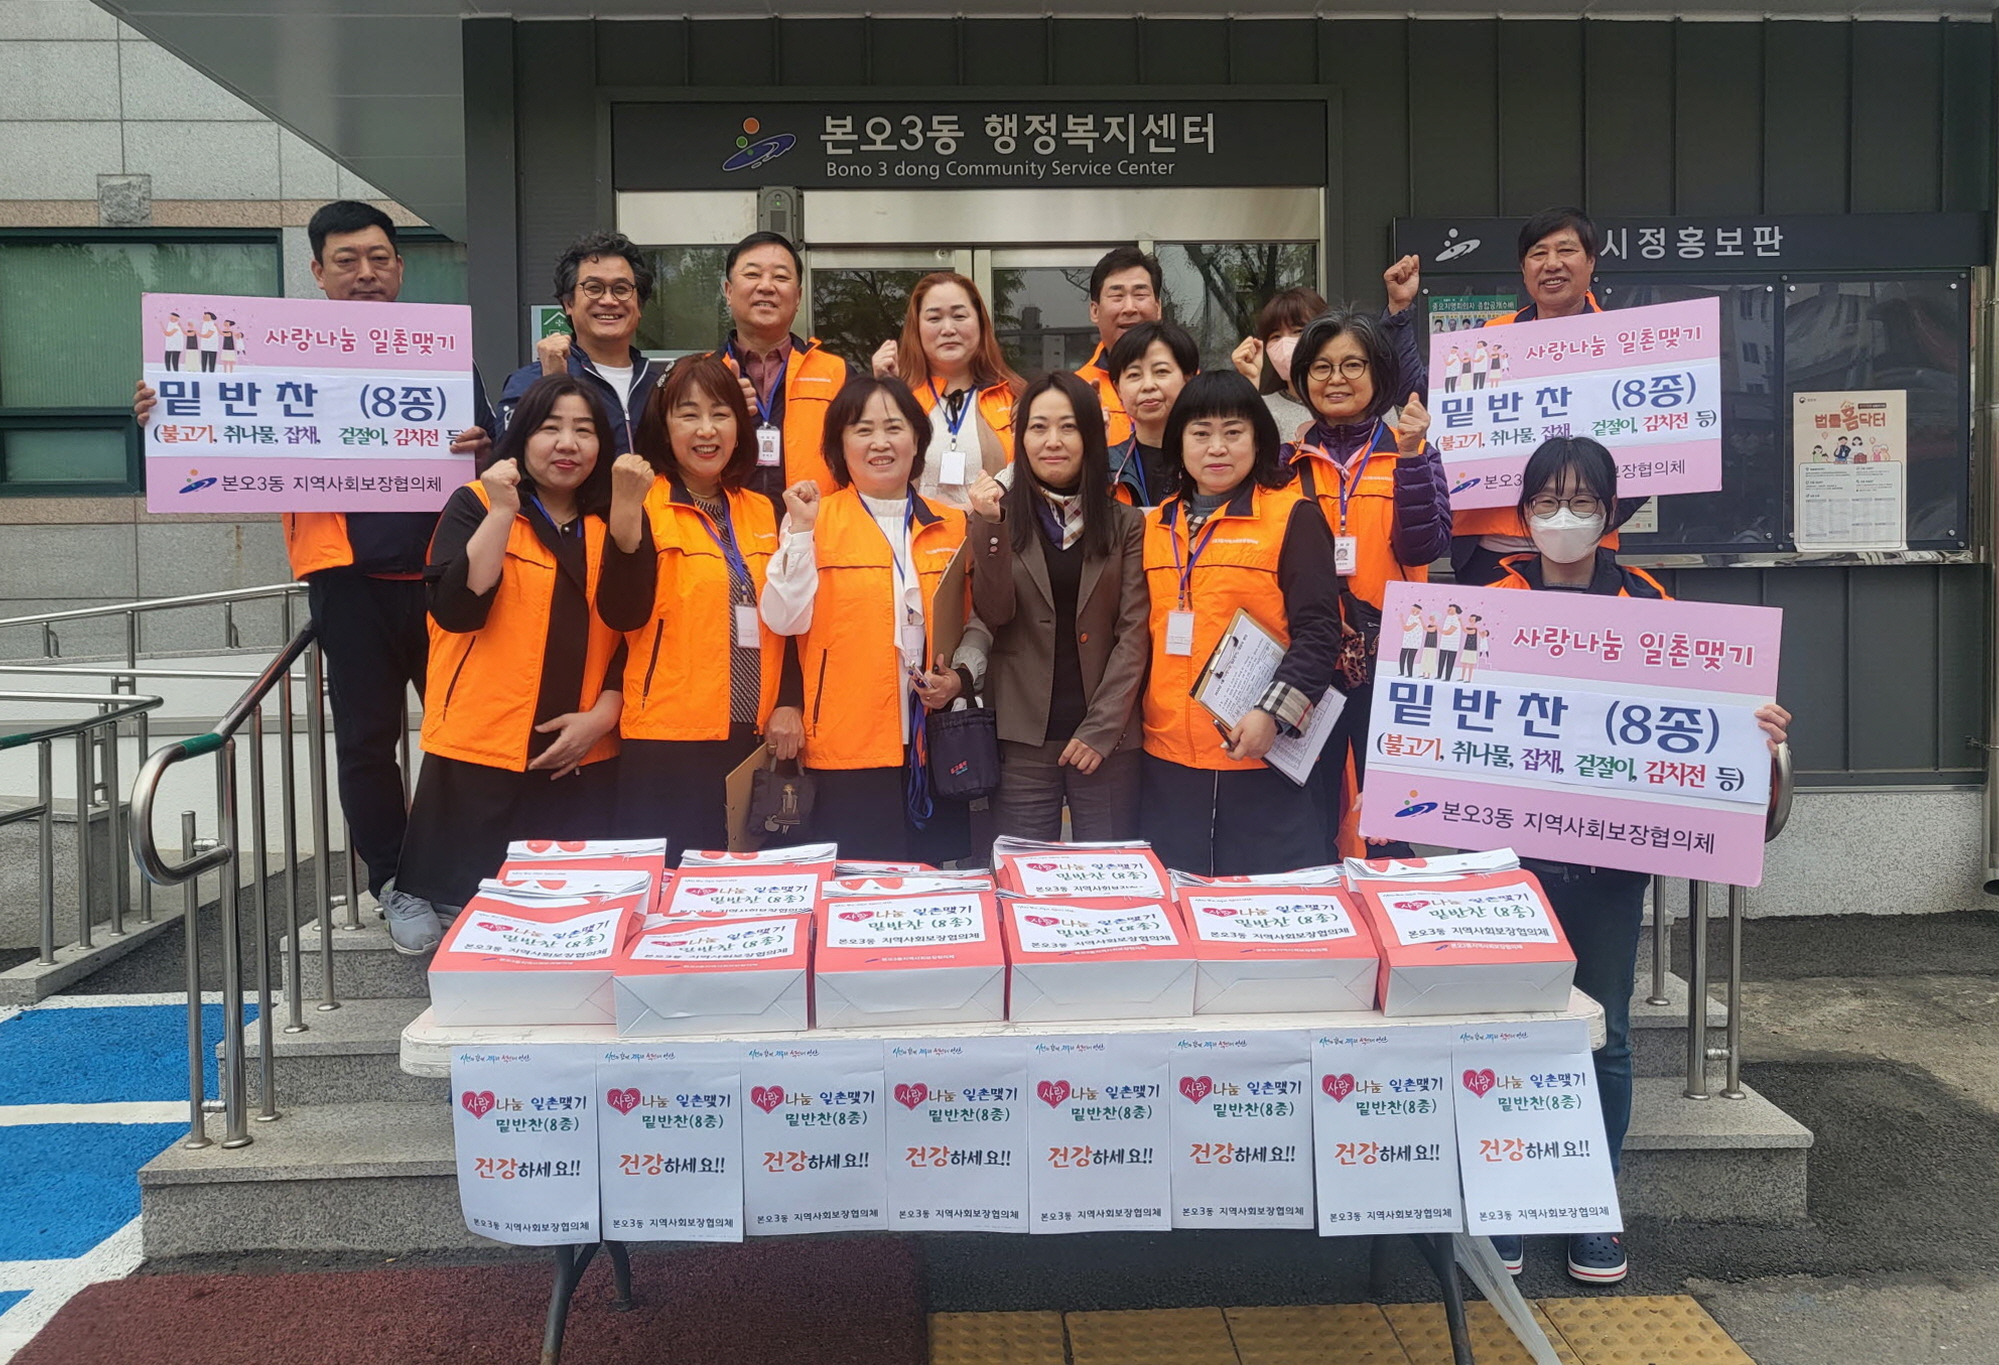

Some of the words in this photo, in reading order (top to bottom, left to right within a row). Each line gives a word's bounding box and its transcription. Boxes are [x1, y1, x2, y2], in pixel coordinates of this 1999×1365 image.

[820, 115, 964, 155] 본오3동
[984, 113, 1215, 156] 행정복지센터
[826, 161, 873, 177] Bono
[878, 162, 888, 177] 3
[894, 161, 940, 180] dong
[945, 160, 1047, 180] Community
[1051, 160, 1112, 177] Service
[1117, 160, 1175, 177] Center
[1600, 225, 1784, 260] 시정홍보판
[265, 328, 356, 352] 사랑나눔
[369, 329, 455, 353] 일촌맺기
[1525, 336, 1607, 362] 사랑나눔
[1617, 326, 1701, 353] 일촌맺기
[1611, 371, 1697, 411] (8종)
[360, 384, 446, 421] (8종)
[153, 424, 218, 444] (불고기,
[223, 425, 278, 444] 취나물,
[283, 425, 321, 444] 잡채,
[338, 426, 388, 446] 겉절이,
[392, 428, 439, 447] 김치전
[1435, 431, 1485, 453] (불고기,
[1489, 427, 1537, 447] 취나물,
[1591, 417, 1639, 437] 겉절이,
[1642, 412, 1689, 434] 김치전
[1695, 409, 1718, 429] 등)
[221, 475, 285, 492] 본오3동
[293, 475, 442, 493] 지역사회보장협의체
[1484, 473, 1523, 489] 본오3
[1512, 627, 1624, 662] 사랑나눔
[1640, 632, 1754, 671] 일촌맺기
[1605, 700, 1720, 755] (8종)
[1376, 732, 1445, 762] (불고기,
[1451, 741, 1514, 770] 취나물,
[1520, 748, 1565, 775] 잡채,
[1574, 754, 1638, 783] 겉절이,
[1644, 760, 1706, 789] 김치전
[1715, 768, 1744, 792] 등)
[1441, 801, 1514, 830] 본오3동
[1522, 811, 1715, 855] 지역사회보장협의체
[1247, 1080, 1301, 1096] 일촌맺기
[1389, 1077, 1443, 1092] 일촌맺기
[1529, 1072, 1586, 1089] 일촌맺기
[675, 1093, 731, 1108] 일촌맺기
[819, 1090, 875, 1105] 일촌맺기
[962, 1087, 1018, 1103] 일촌맺기
[1105, 1084, 1160, 1099] 일촌맺기
[530, 1095, 587, 1111] 일촌맺기
[1213, 1101, 1294, 1118] 밑반찬(8종)
[1356, 1100, 1437, 1117] 밑반찬(8종)
[1497, 1094, 1582, 1112] 밑반찬(8종)
[641, 1114, 724, 1130] 밑반찬(8종)
[785, 1110, 868, 1127] 밑반찬(8종)
[928, 1106, 1010, 1123] 밑반찬(8종)
[1071, 1104, 1153, 1122] 밑반찬(8종)
[495, 1118, 580, 1134] 밑반찬(8종)
[905, 1145, 1011, 1168] 건강하세요!!
[1047, 1145, 1153, 1169] 건강하세요!!
[1189, 1142, 1295, 1165] 건강하세요!!
[1334, 1141, 1440, 1165] 건강하세요!!
[1479, 1137, 1590, 1162] 건강하세요!!
[474, 1157, 581, 1180] 건강하세요!!
[618, 1153, 725, 1176] 건강하세요!!
[762, 1150, 869, 1173] 건강하세요!!
[756, 1214, 788, 1224] 본오3동
[793, 1208, 879, 1222] 지역사회보장협의체
[898, 1209, 930, 1220] 본오3동
[935, 1209, 1019, 1220] 지역사회보장협의체
[1040, 1210, 1072, 1222] 본오3동
[1077, 1207, 1162, 1219] 지역사회보장협의체
[1182, 1206, 1214, 1216] 본오3동
[1219, 1206, 1304, 1216] 지역사회보장협의체
[1329, 1211, 1362, 1223] 본오3동
[1366, 1208, 1452, 1221] 지역사회보장협의체
[1479, 1209, 1513, 1222] 본오3동
[1517, 1205, 1610, 1219] 지역사회보장협의체
[473, 1218, 500, 1231] 본오3동
[504, 1220, 590, 1232] 지역사회보장협의체
[612, 1218, 644, 1229] 본오3동
[649, 1218, 734, 1228] 지역사회보장협의체
